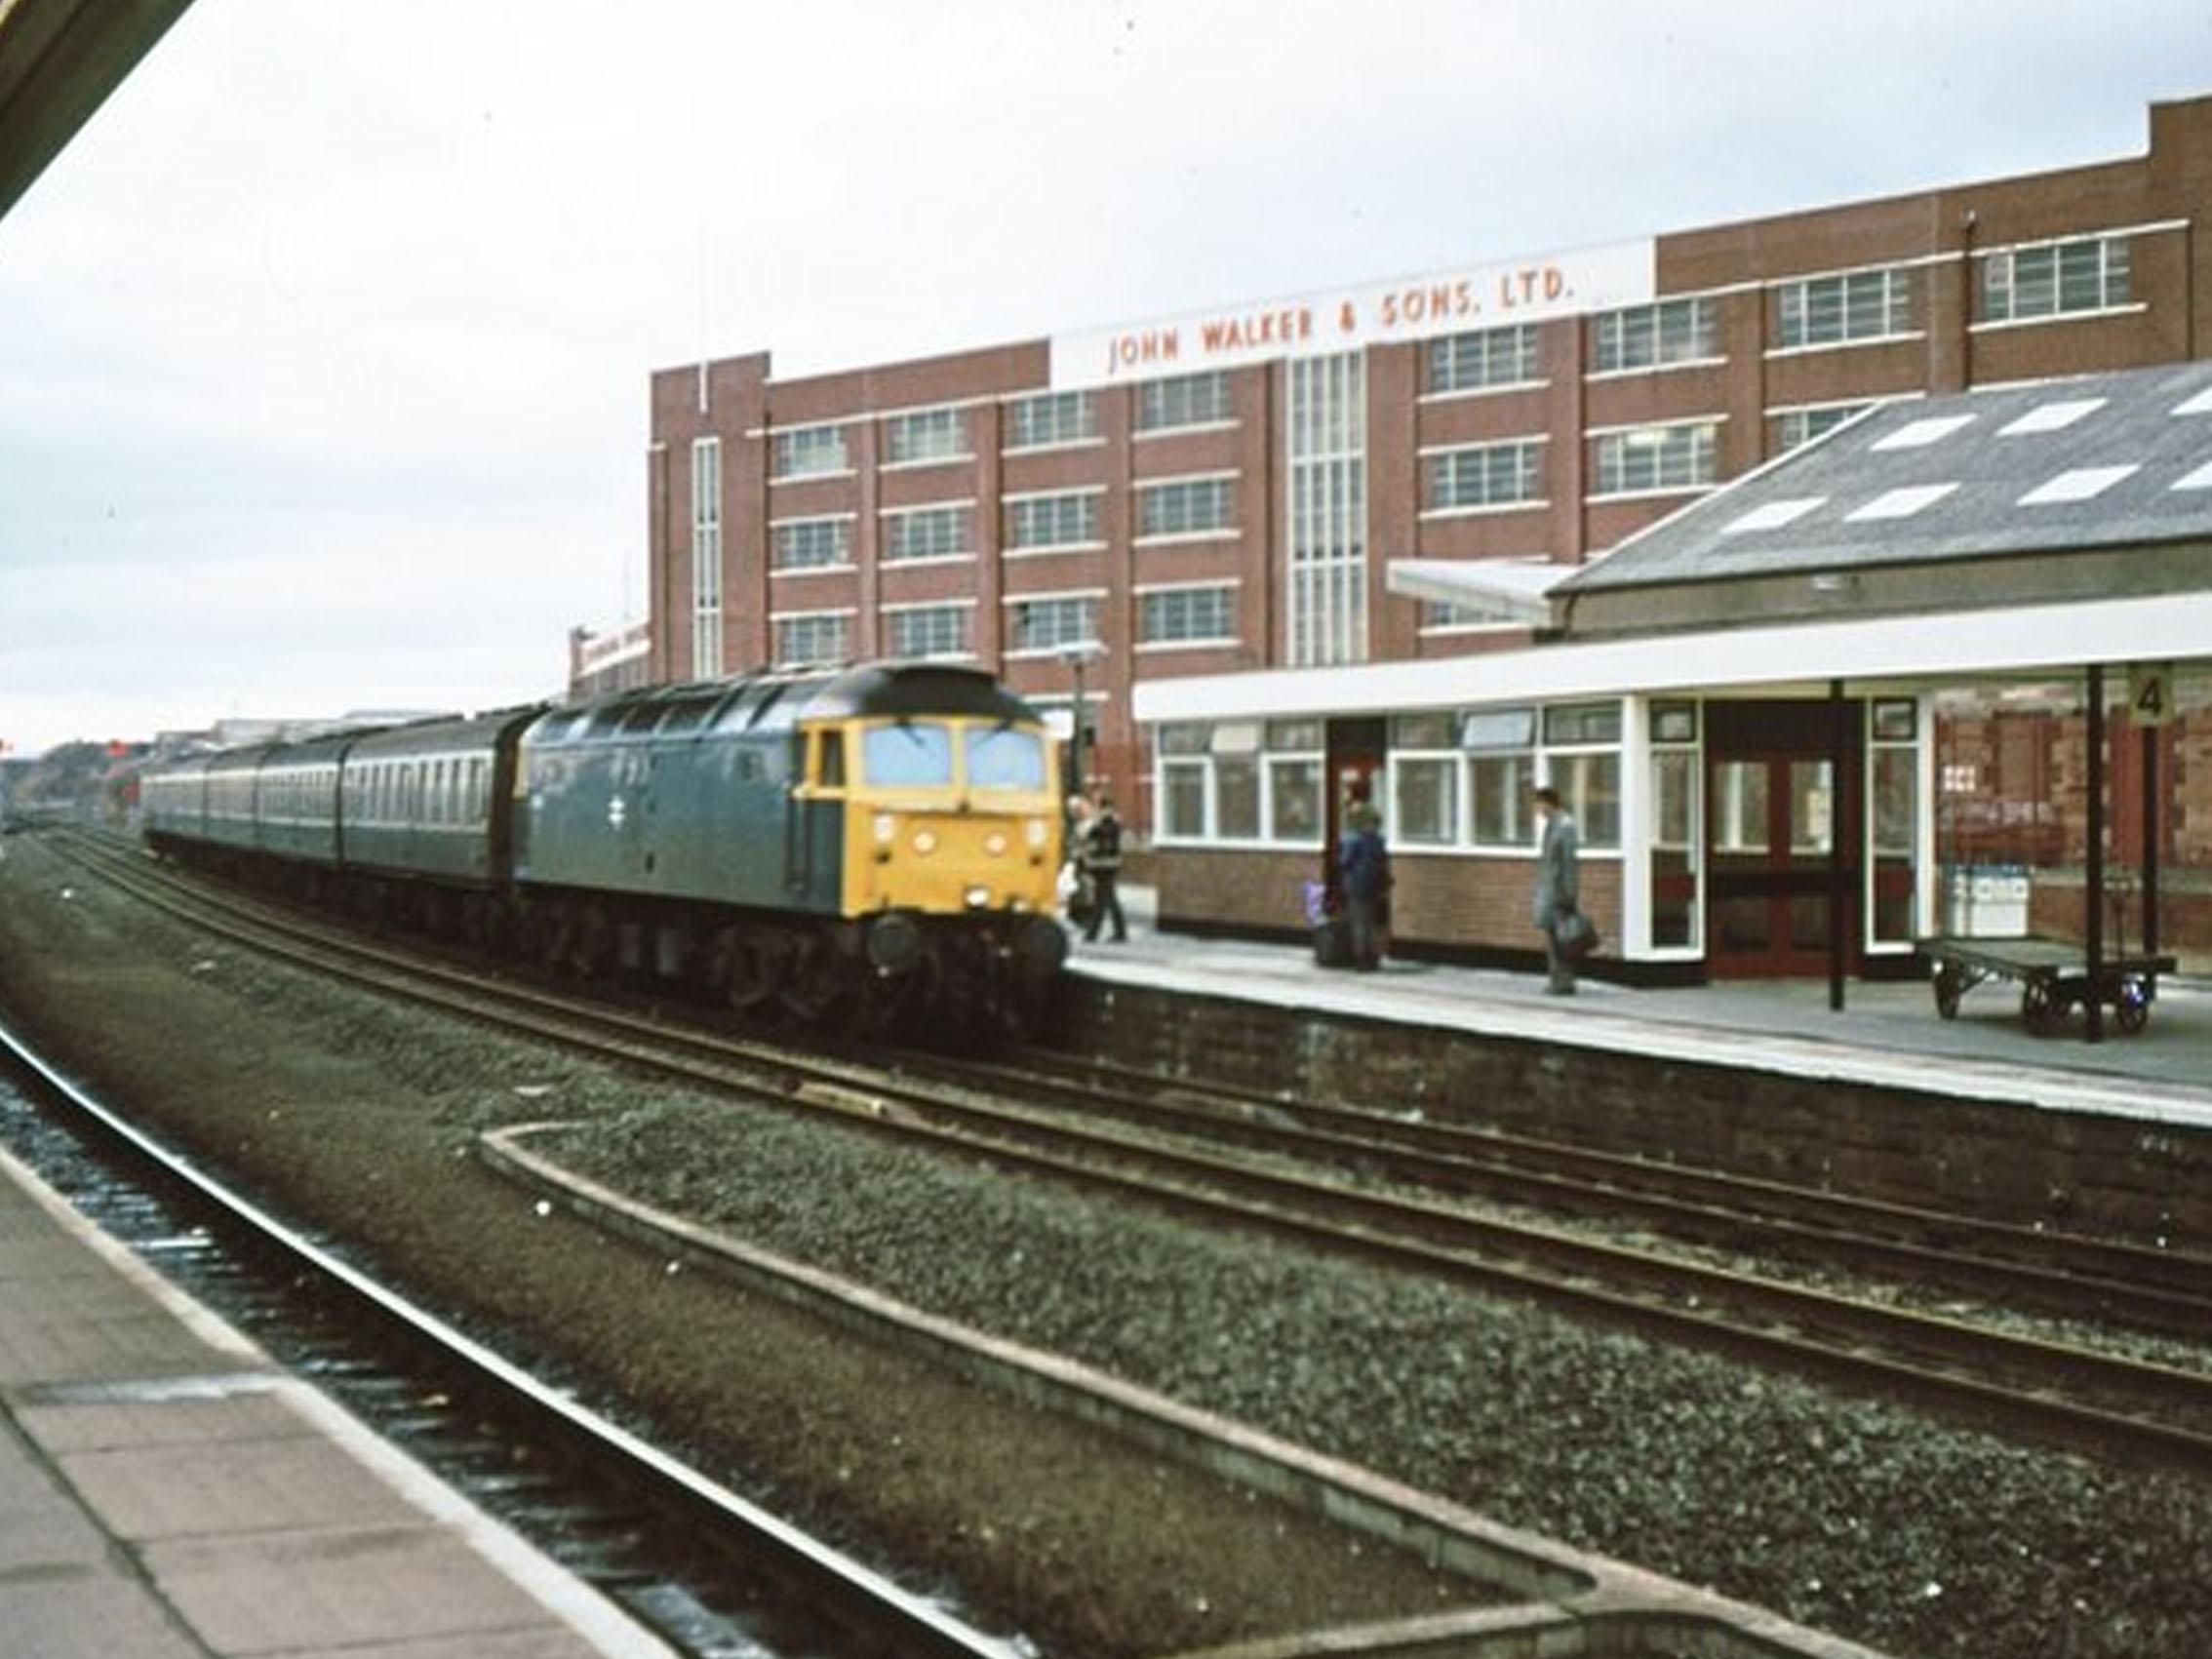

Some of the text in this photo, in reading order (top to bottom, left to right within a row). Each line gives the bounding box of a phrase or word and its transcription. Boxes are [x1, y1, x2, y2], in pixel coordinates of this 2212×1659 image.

[1109, 327, 1178, 374] JOHN
[1202, 308, 1311, 351] WALKER
[1500, 268, 1574, 307] LTD.
[2138, 677, 2162, 717] 4
